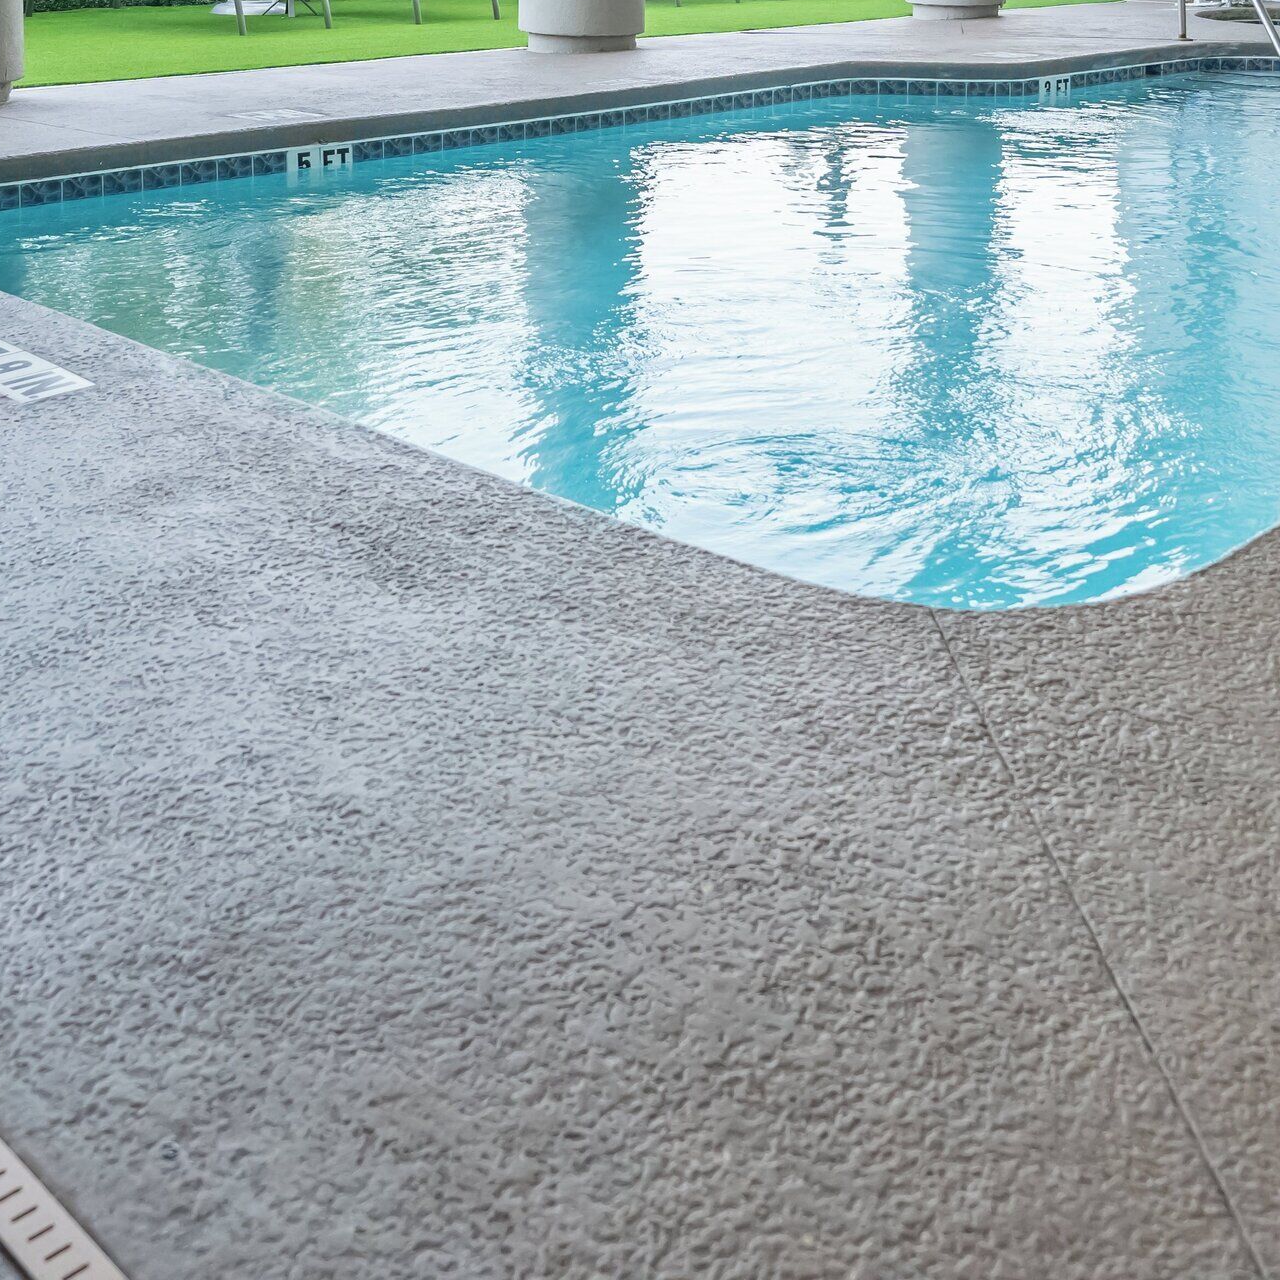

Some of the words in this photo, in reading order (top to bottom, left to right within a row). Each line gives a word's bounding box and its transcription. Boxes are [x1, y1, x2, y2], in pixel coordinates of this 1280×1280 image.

[1056, 78, 1069, 93] FT
[297, 152, 311, 169] 5
[323, 148, 349, 166] FT
